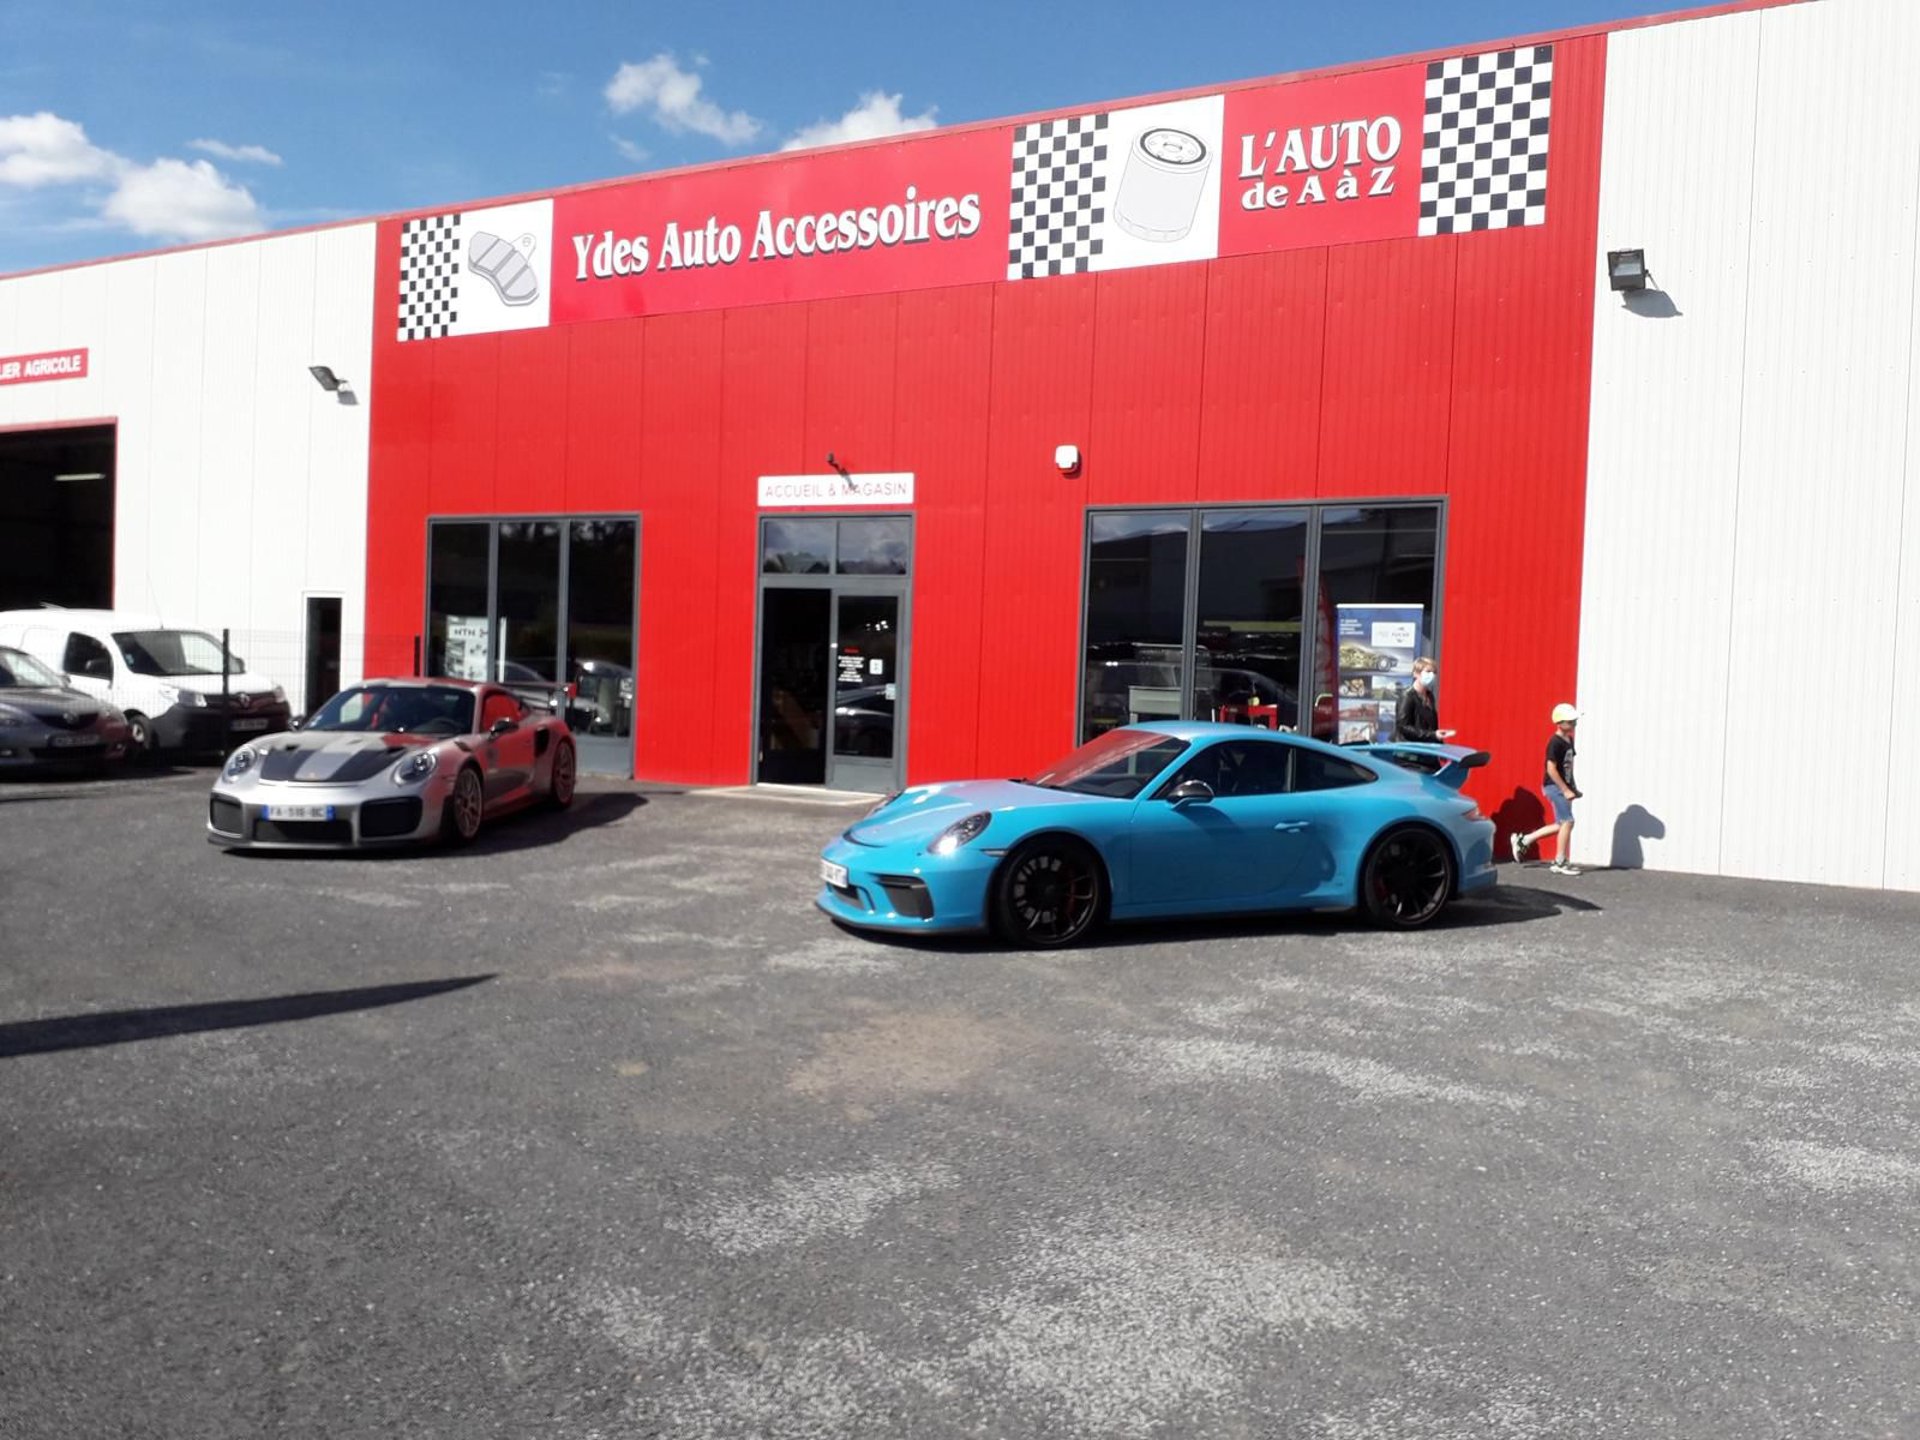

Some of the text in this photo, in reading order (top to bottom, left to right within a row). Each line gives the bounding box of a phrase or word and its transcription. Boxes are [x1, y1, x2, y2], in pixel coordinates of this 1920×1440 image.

[1239, 116, 1401, 180] L'AUTO
[1241, 164, 1396, 211] de A à Z
[572, 185, 981, 282] Ydes Auto Accessoires
[24, 355, 82, 377] AGRICOLE
[765, 481, 907, 498] ACCUEIL & MAGASIN
